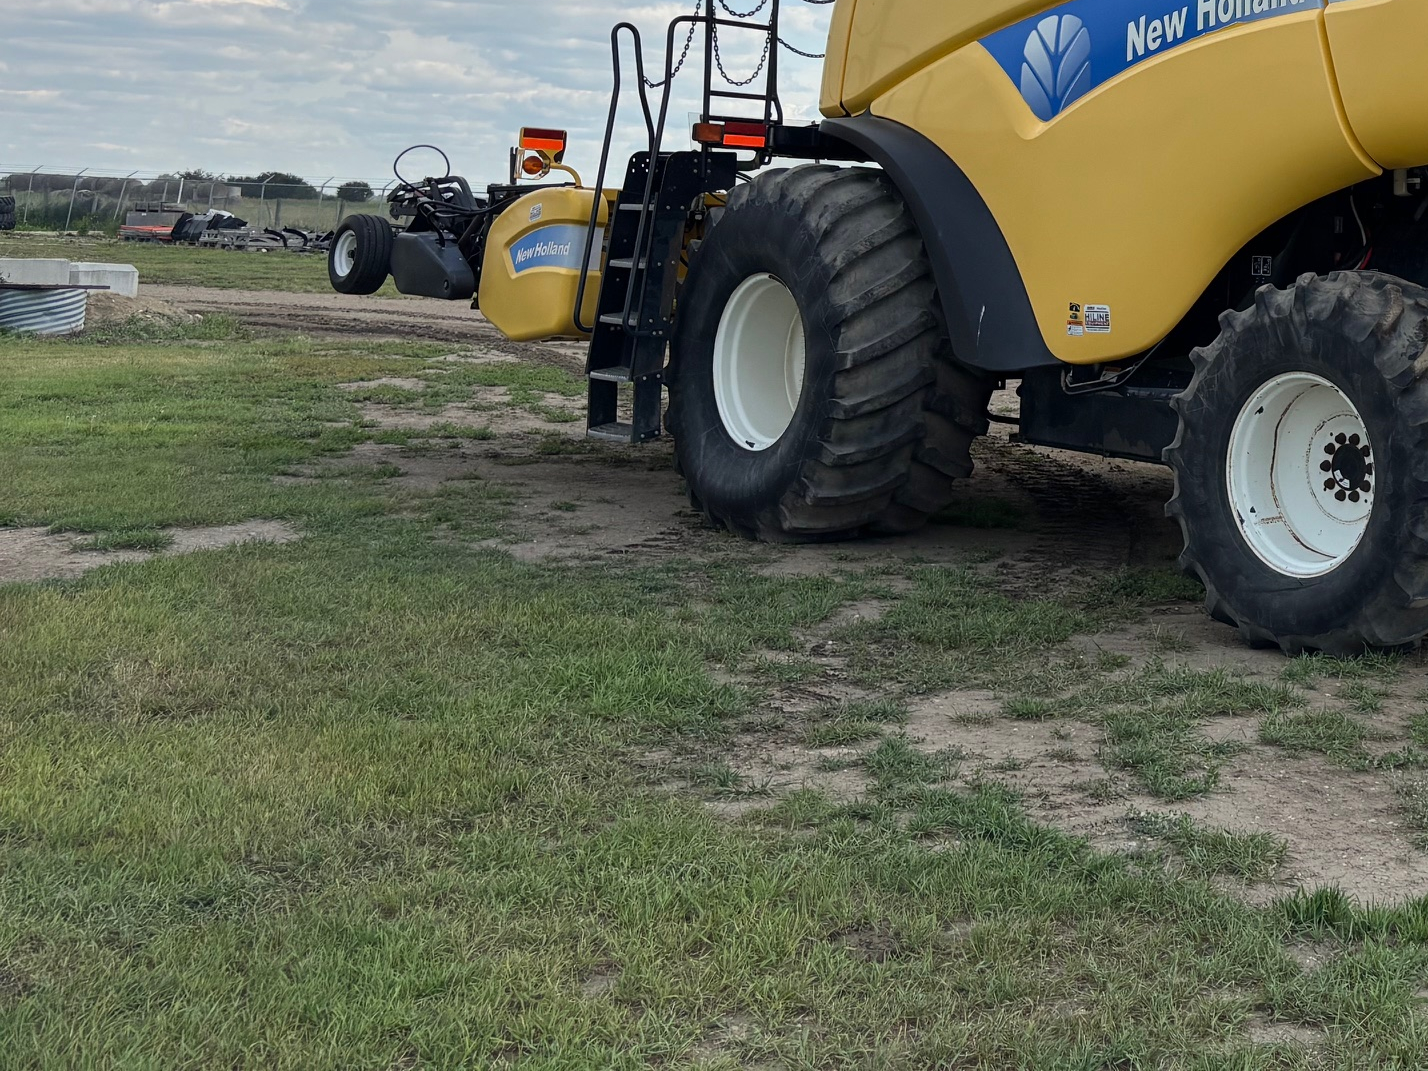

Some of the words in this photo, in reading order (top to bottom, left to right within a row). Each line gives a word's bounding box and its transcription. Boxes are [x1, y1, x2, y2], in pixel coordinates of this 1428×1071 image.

[1126, 2, 1188, 62] New
[515, 248, 534, 265] New
[534, 241, 571, 257] Holland
